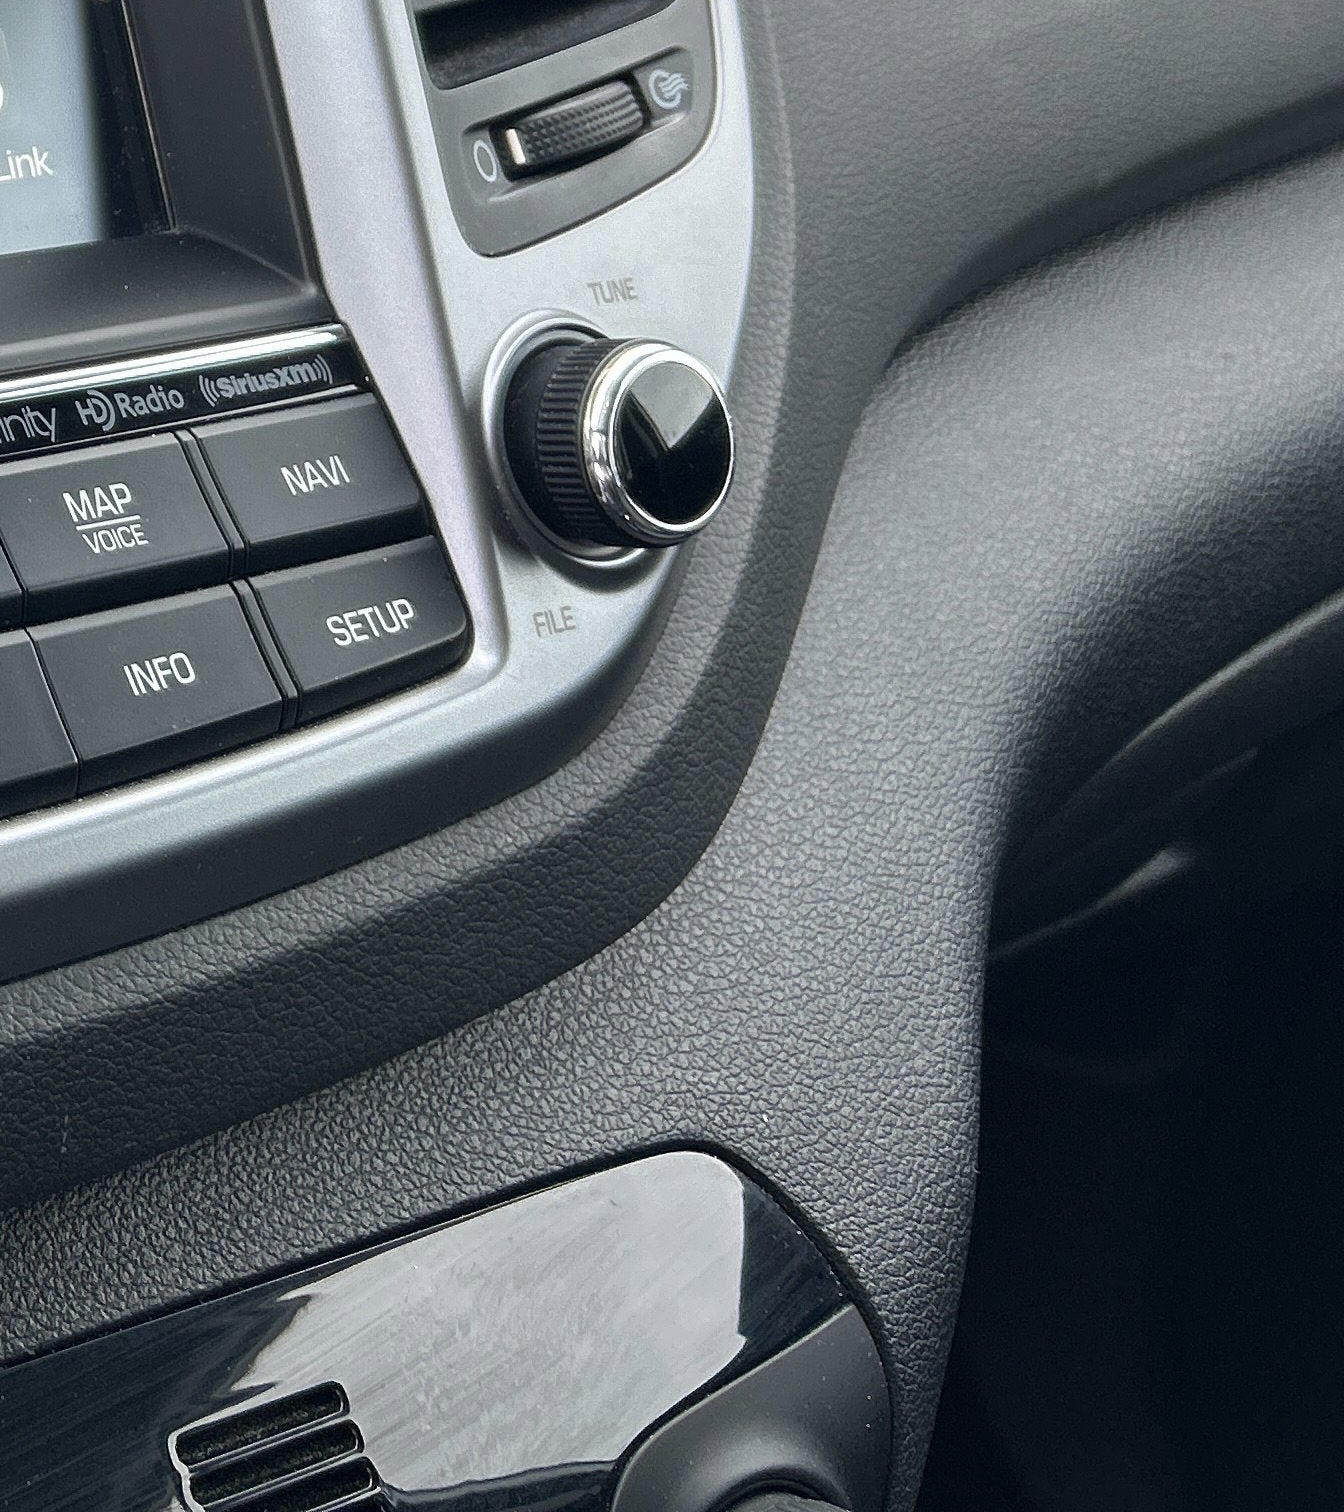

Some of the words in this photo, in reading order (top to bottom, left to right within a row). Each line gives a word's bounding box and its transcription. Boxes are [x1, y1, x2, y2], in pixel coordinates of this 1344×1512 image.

[587, 277, 640, 306] TUNE
[75, 389, 117, 432] HD
[118, 384, 185, 420] Radio
[280, 455, 351, 497] NAVI
[62, 482, 134, 524] MAP
[82, 523, 149, 554] VOICE
[326, 598, 416, 648] SETUP
[532, 604, 577, 635] FILE
[123, 651, 197, 697] INFO
